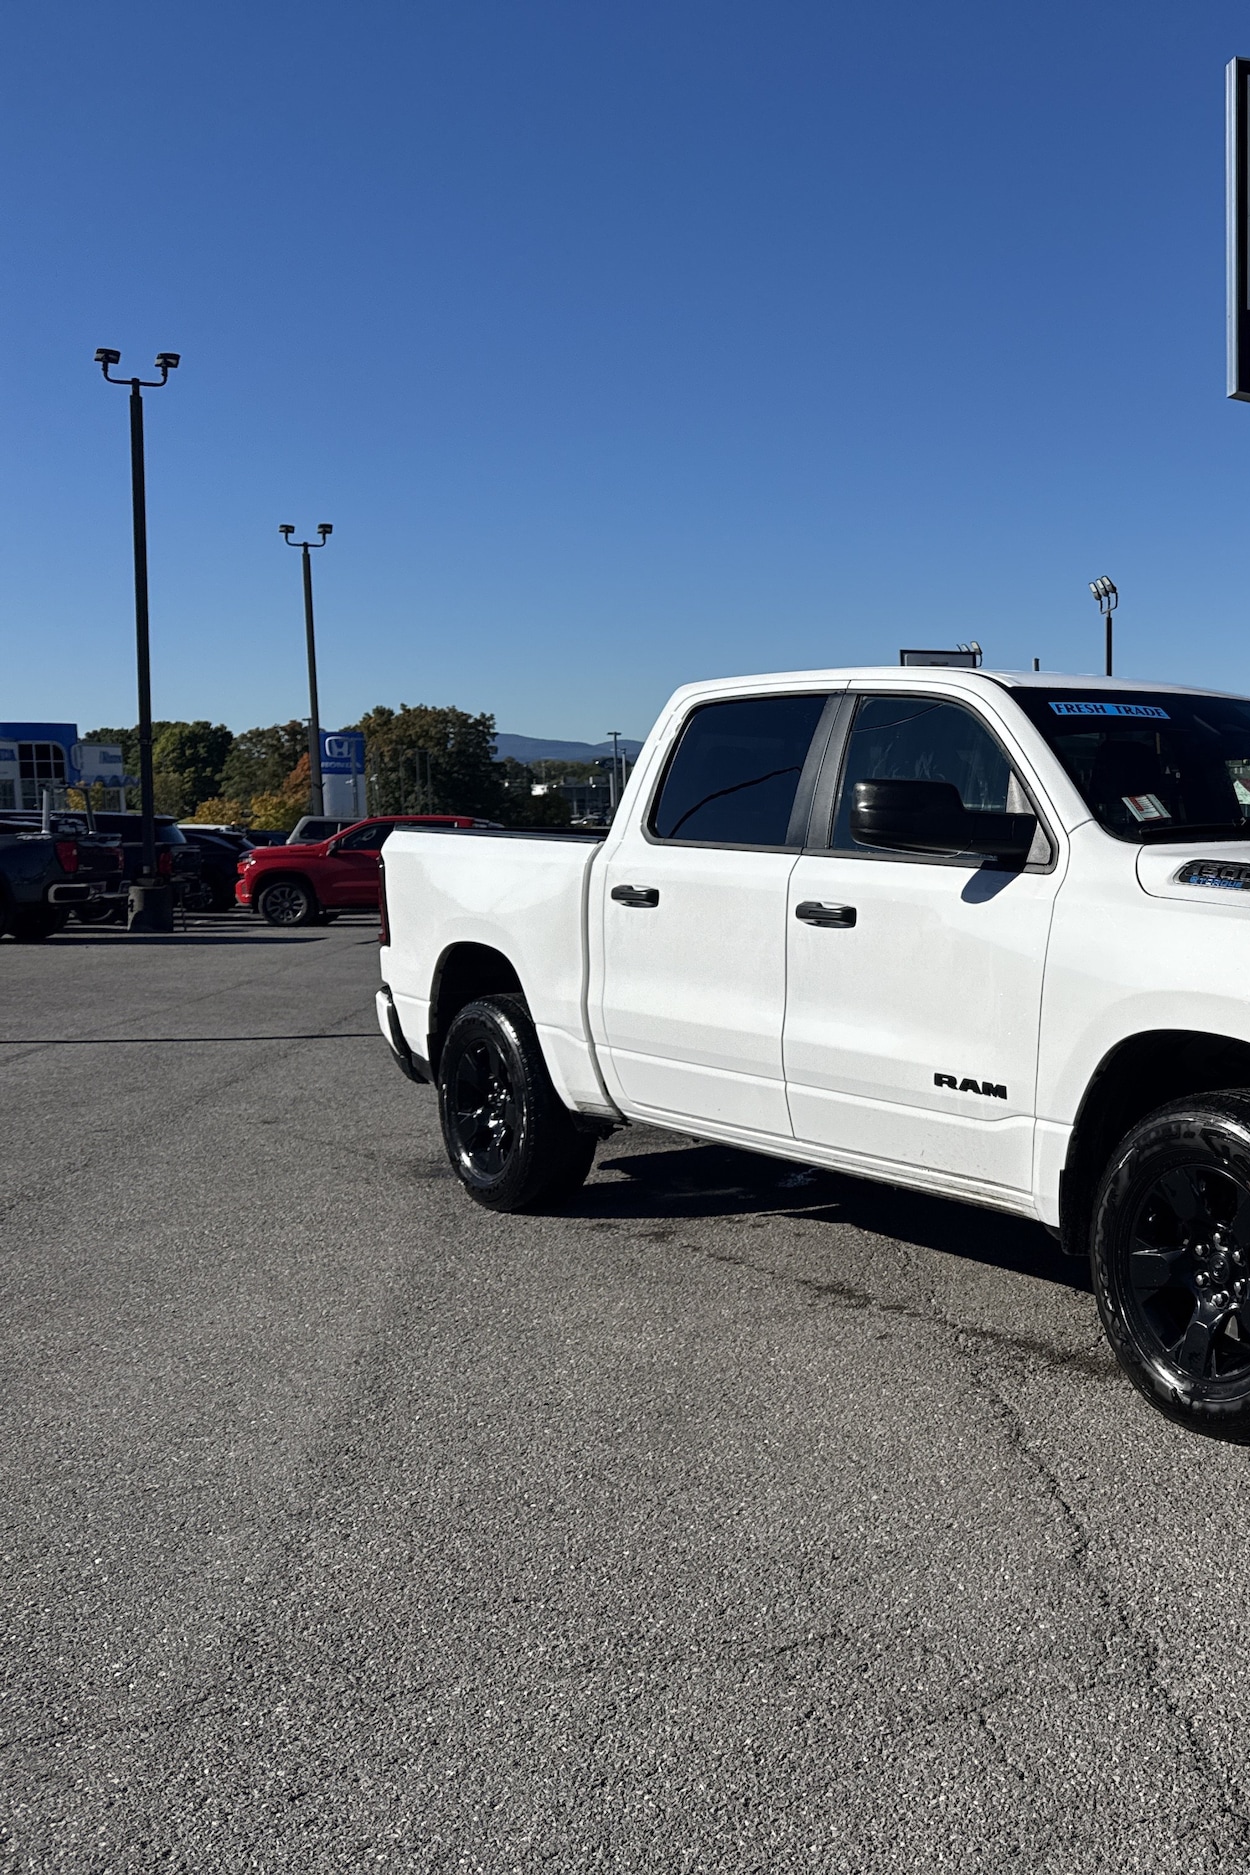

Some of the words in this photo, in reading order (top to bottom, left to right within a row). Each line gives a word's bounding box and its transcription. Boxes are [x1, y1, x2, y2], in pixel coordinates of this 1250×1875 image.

[1054, 703, 1107, 714] FRESH
[1113, 705, 1167, 717] TRADE
[934, 1072, 1007, 1100] RAM
